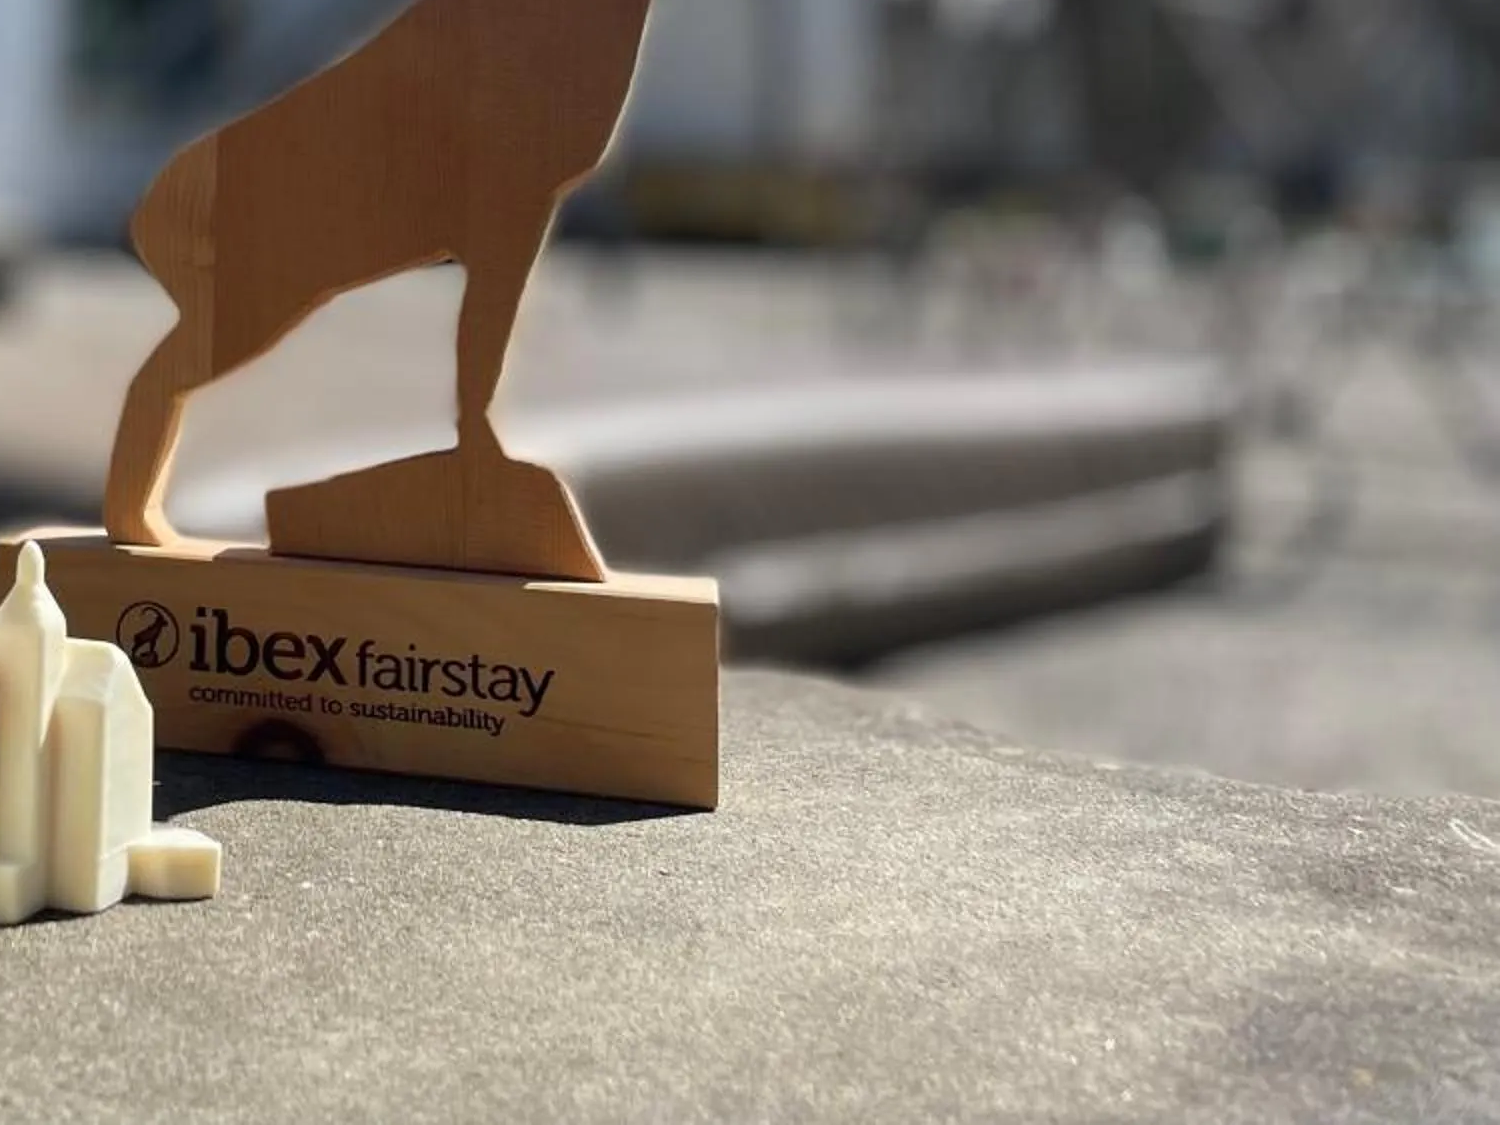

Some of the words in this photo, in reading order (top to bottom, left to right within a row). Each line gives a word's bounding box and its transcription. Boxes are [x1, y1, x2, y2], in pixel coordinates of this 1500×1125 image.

[189, 606, 348, 687] ibex
[355, 640, 555, 718] fairstay
[189, 686, 311, 713] committed
[320, 696, 343, 717] to
[349, 700, 506, 737] sustainability
